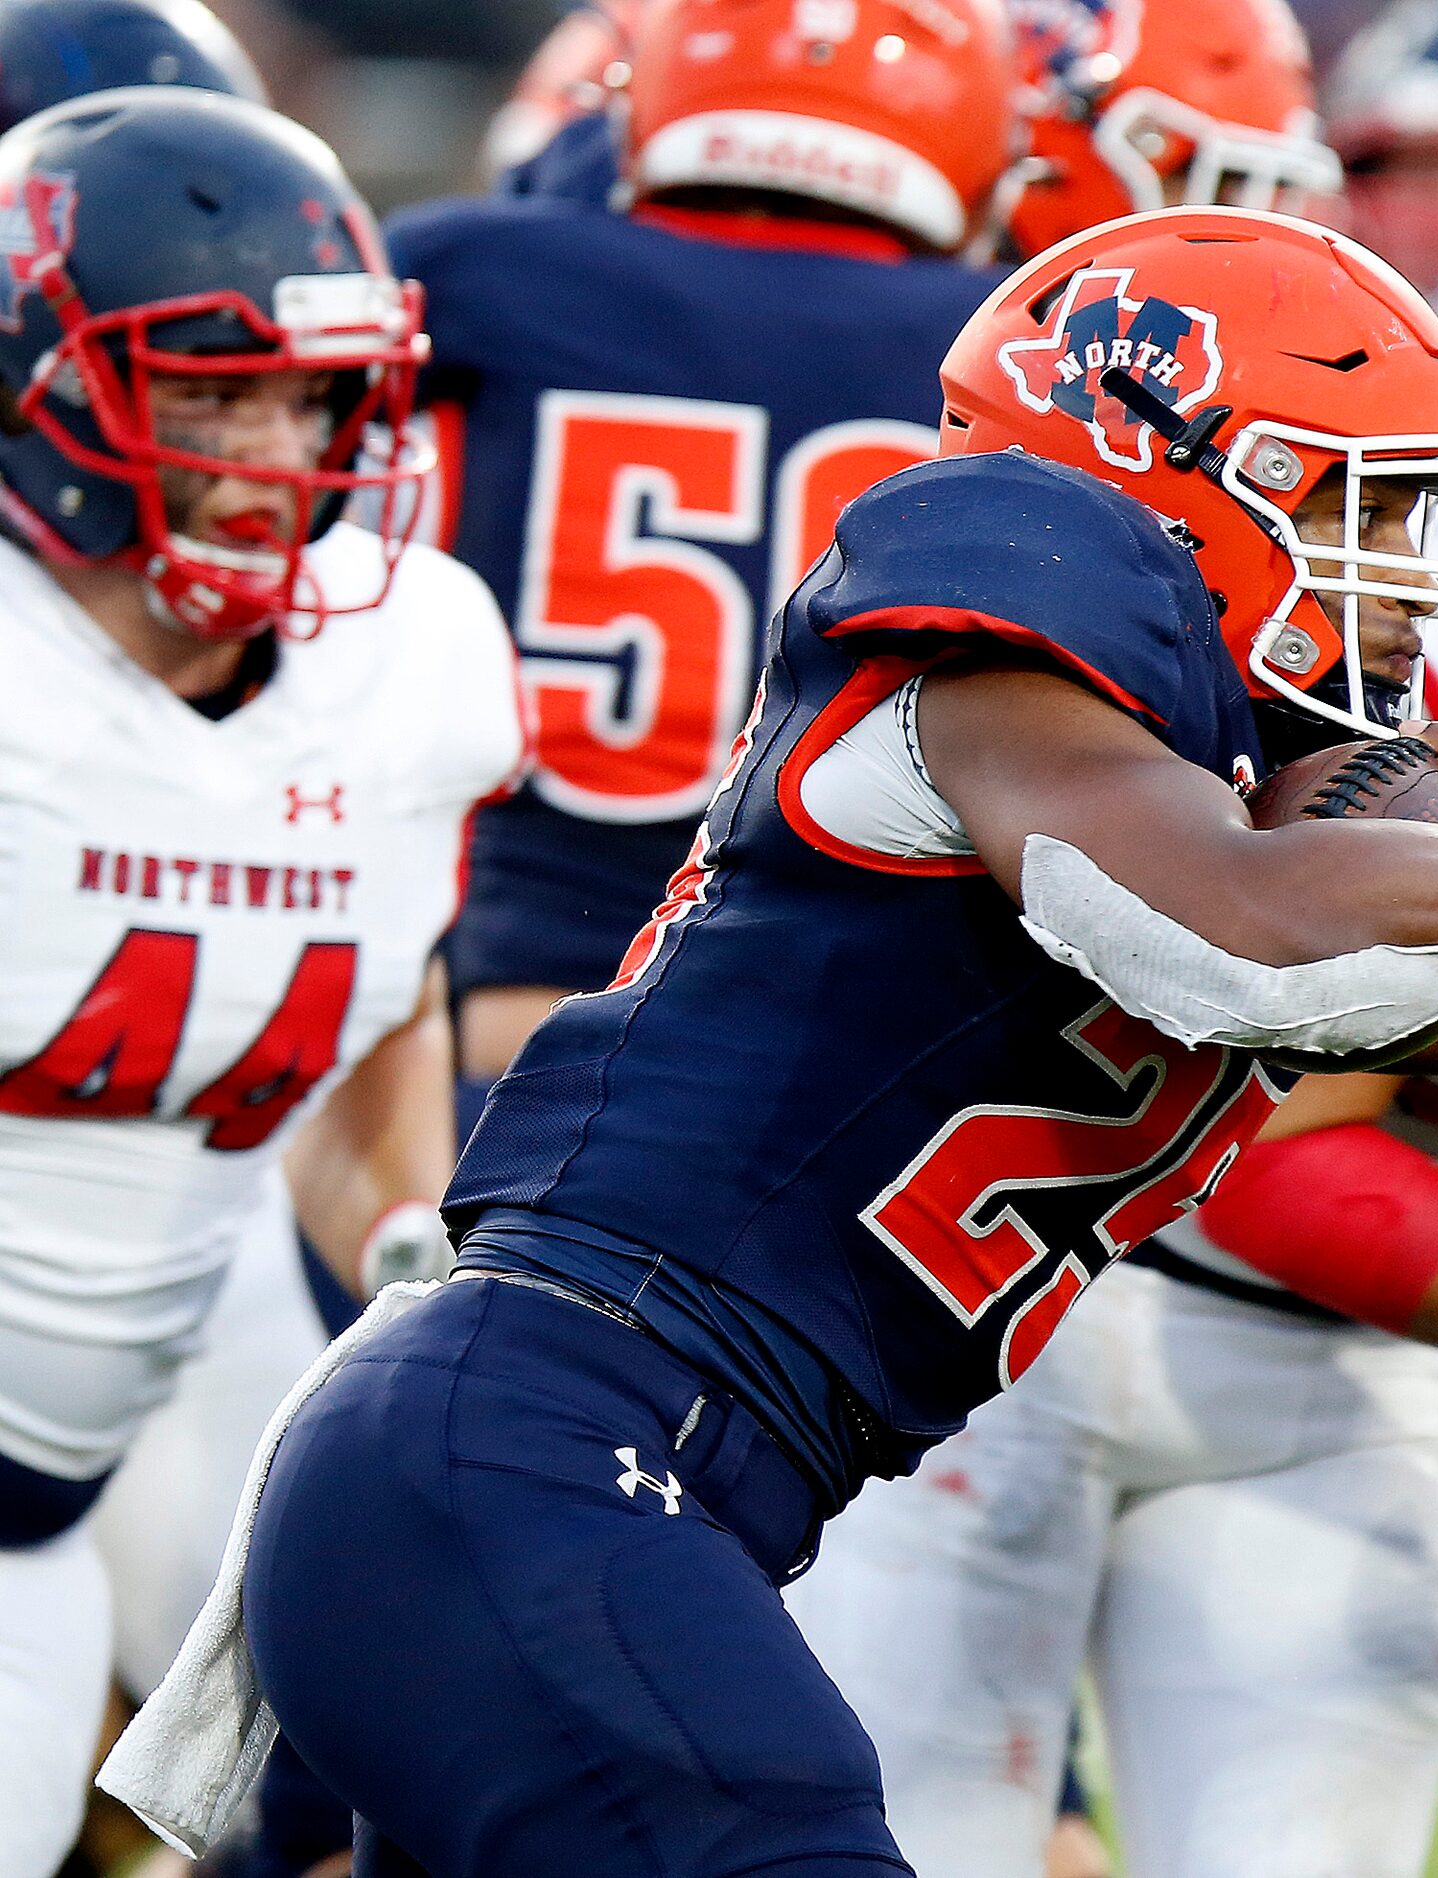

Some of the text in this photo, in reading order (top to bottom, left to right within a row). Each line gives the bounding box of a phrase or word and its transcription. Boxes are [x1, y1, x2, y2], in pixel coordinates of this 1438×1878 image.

[1054, 338, 1185, 387] NORTH
[78, 846, 356, 912] NORTHWEST
[0, 927, 360, 1153] 44
